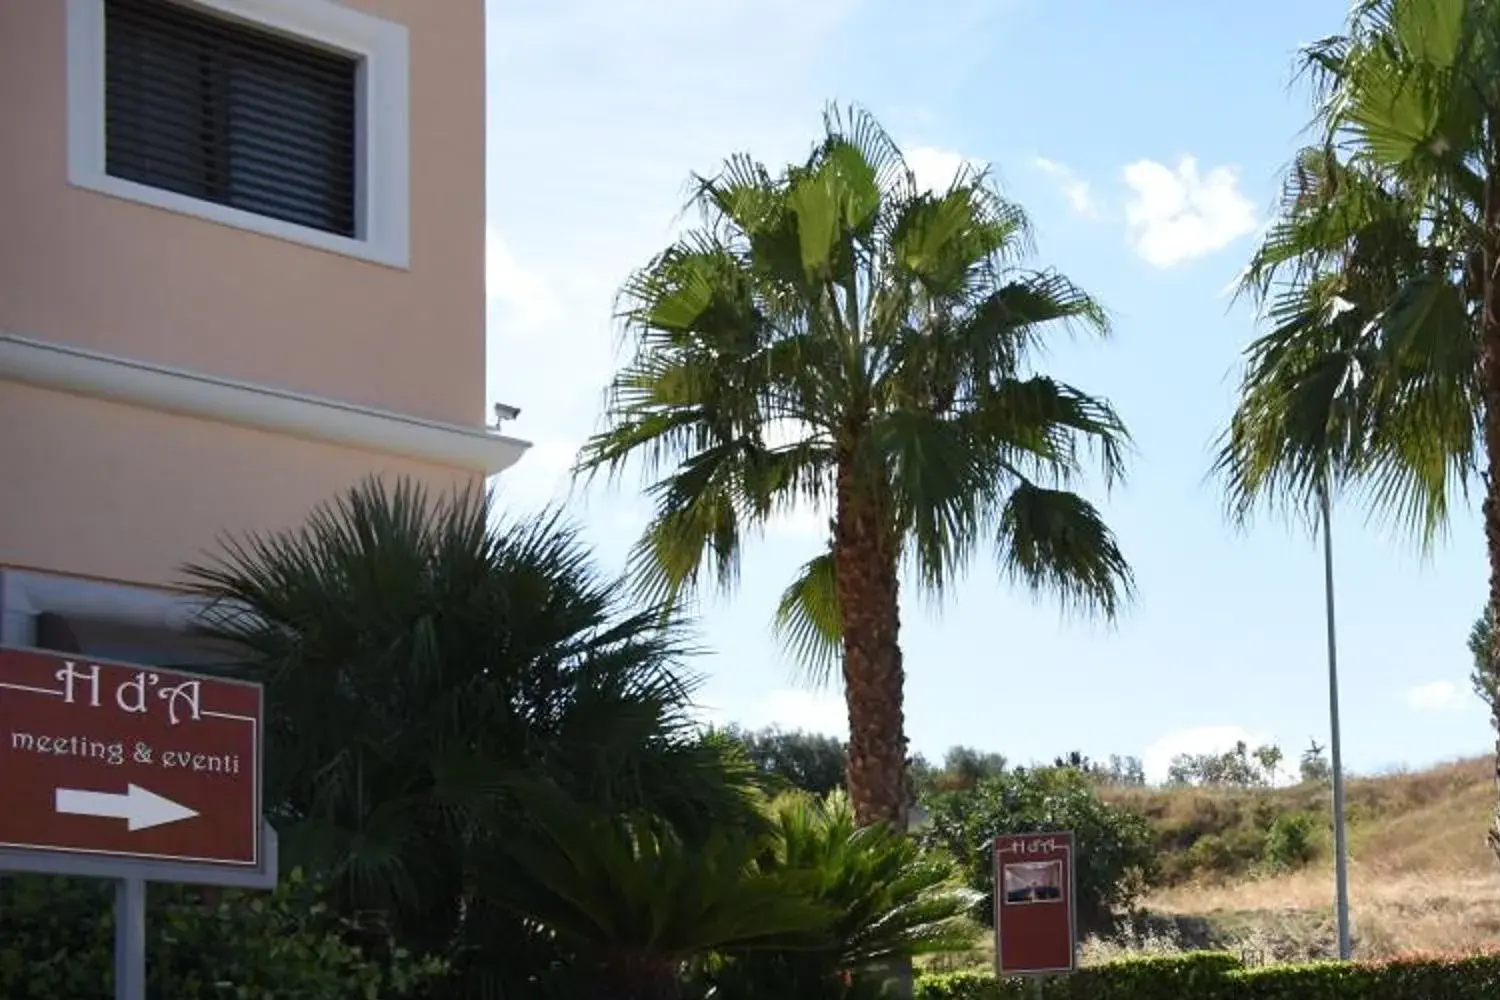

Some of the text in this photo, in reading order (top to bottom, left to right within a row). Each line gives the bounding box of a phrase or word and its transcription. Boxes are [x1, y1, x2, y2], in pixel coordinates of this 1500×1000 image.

[54, 660, 102, 708] H
[11, 731, 241, 774] meeting & eventi
